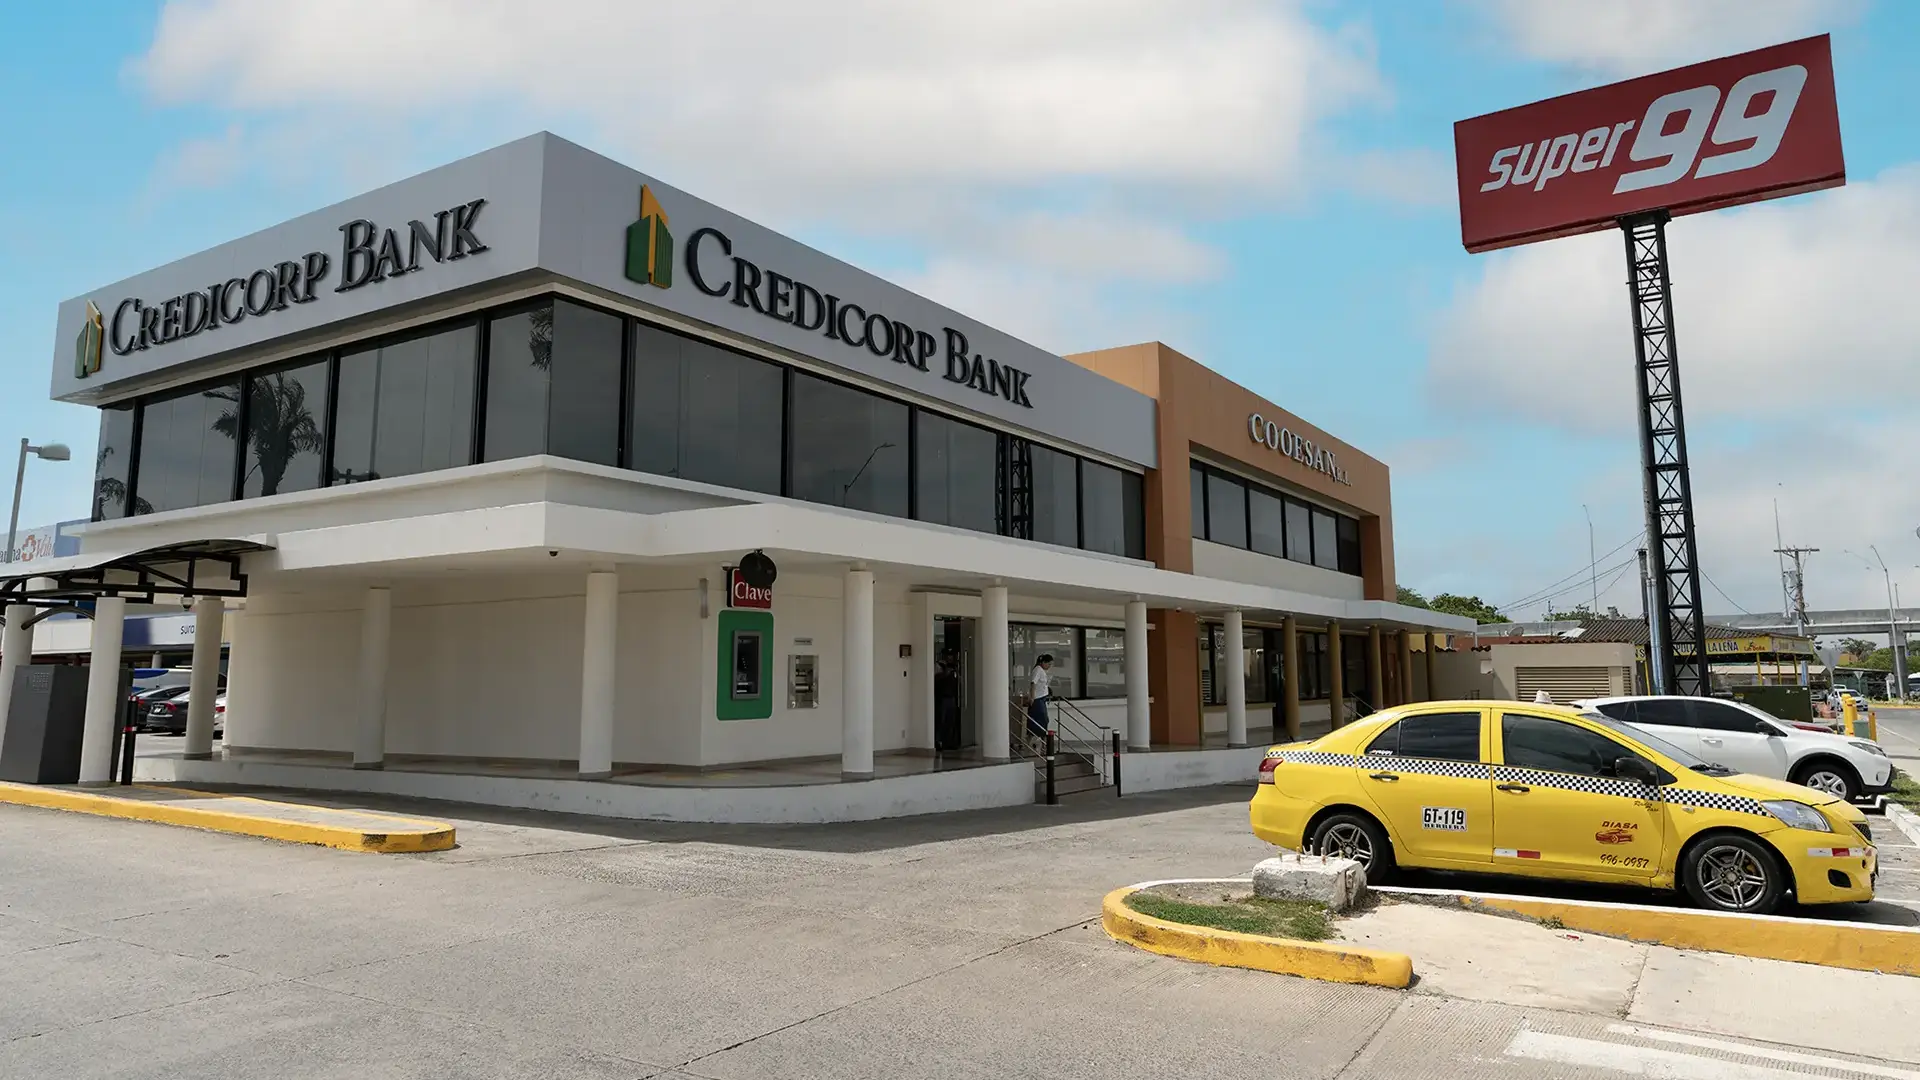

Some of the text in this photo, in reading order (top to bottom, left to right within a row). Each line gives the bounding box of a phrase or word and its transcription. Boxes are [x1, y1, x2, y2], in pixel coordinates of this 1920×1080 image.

[1480, 64, 1808, 195] super 99
[109, 198, 489, 356] CREDICORP BANK
[687, 227, 1034, 409] CREDICORP BANK
[1248, 413, 1336, 482] COOESAN
[734, 581, 772, 601] Clave
[1707, 642, 1718, 652] LA
[1424, 808, 1464, 825] 6T-119
[1602, 821, 1638, 829] DIASA
[1600, 853, 1649, 868] 996-0987
